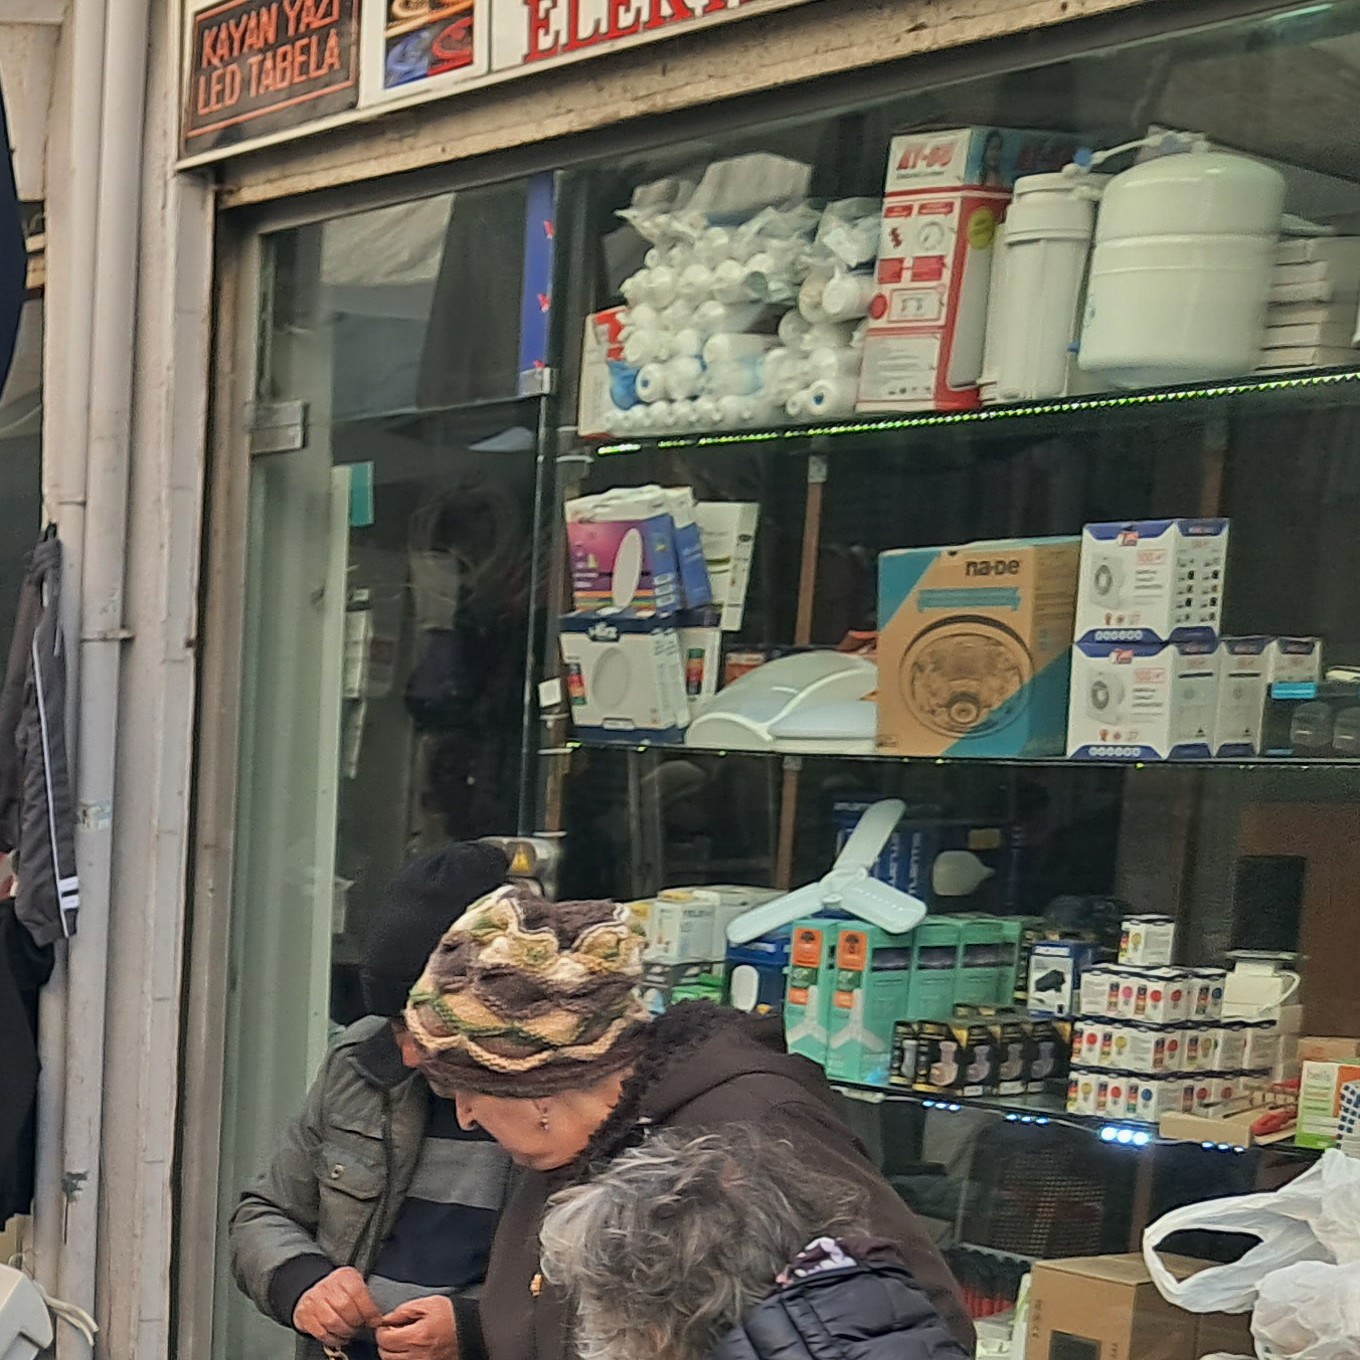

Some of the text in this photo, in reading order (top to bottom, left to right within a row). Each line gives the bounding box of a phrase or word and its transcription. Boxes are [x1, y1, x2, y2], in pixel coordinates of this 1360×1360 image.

[197, 28, 341, 116] LED TABELA
[201, 3, 279, 69] KAYAN
